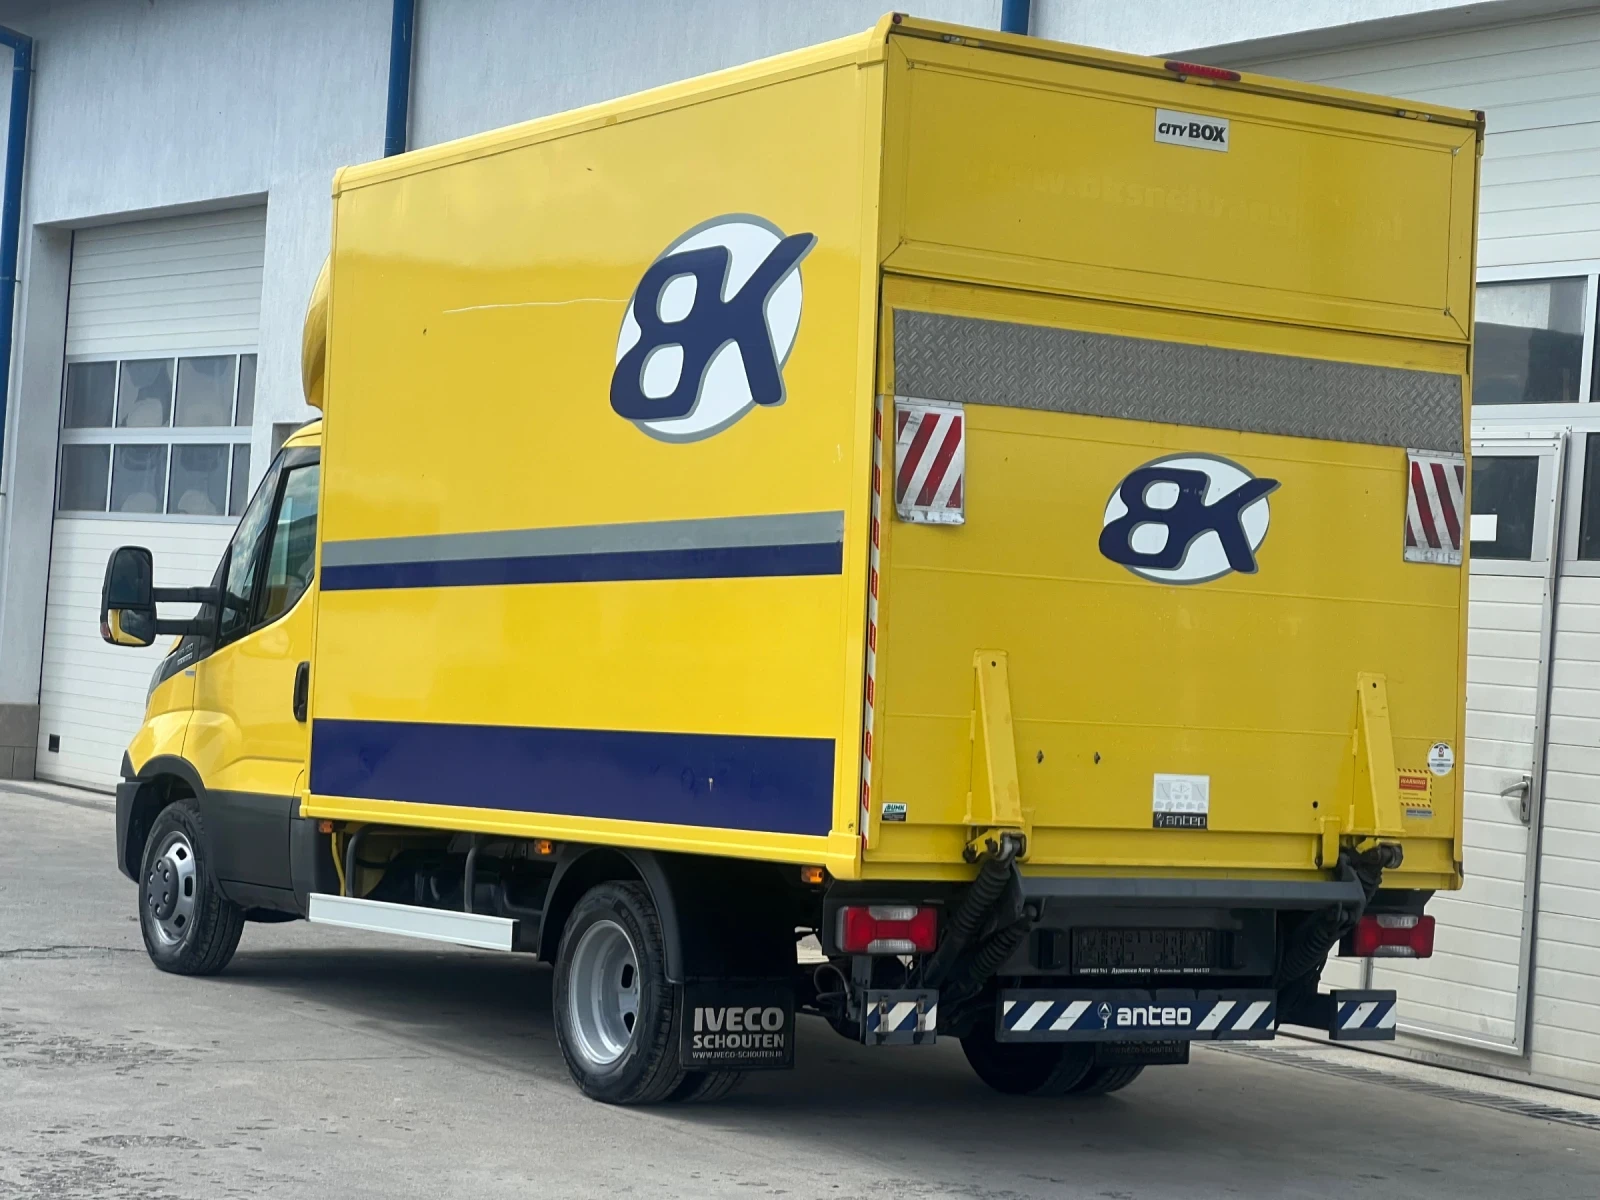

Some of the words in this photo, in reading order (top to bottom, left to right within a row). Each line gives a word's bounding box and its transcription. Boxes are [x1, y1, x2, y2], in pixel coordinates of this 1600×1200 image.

[1158, 122, 1187, 137] CITY
[1188, 121, 1226, 143] BOX
[1166, 815, 1206, 827] anteo
[693, 1007, 785, 1032] IVECO
[1116, 1005, 1192, 1027] anteo
[692, 1033, 785, 1049] SCHOUTEN
